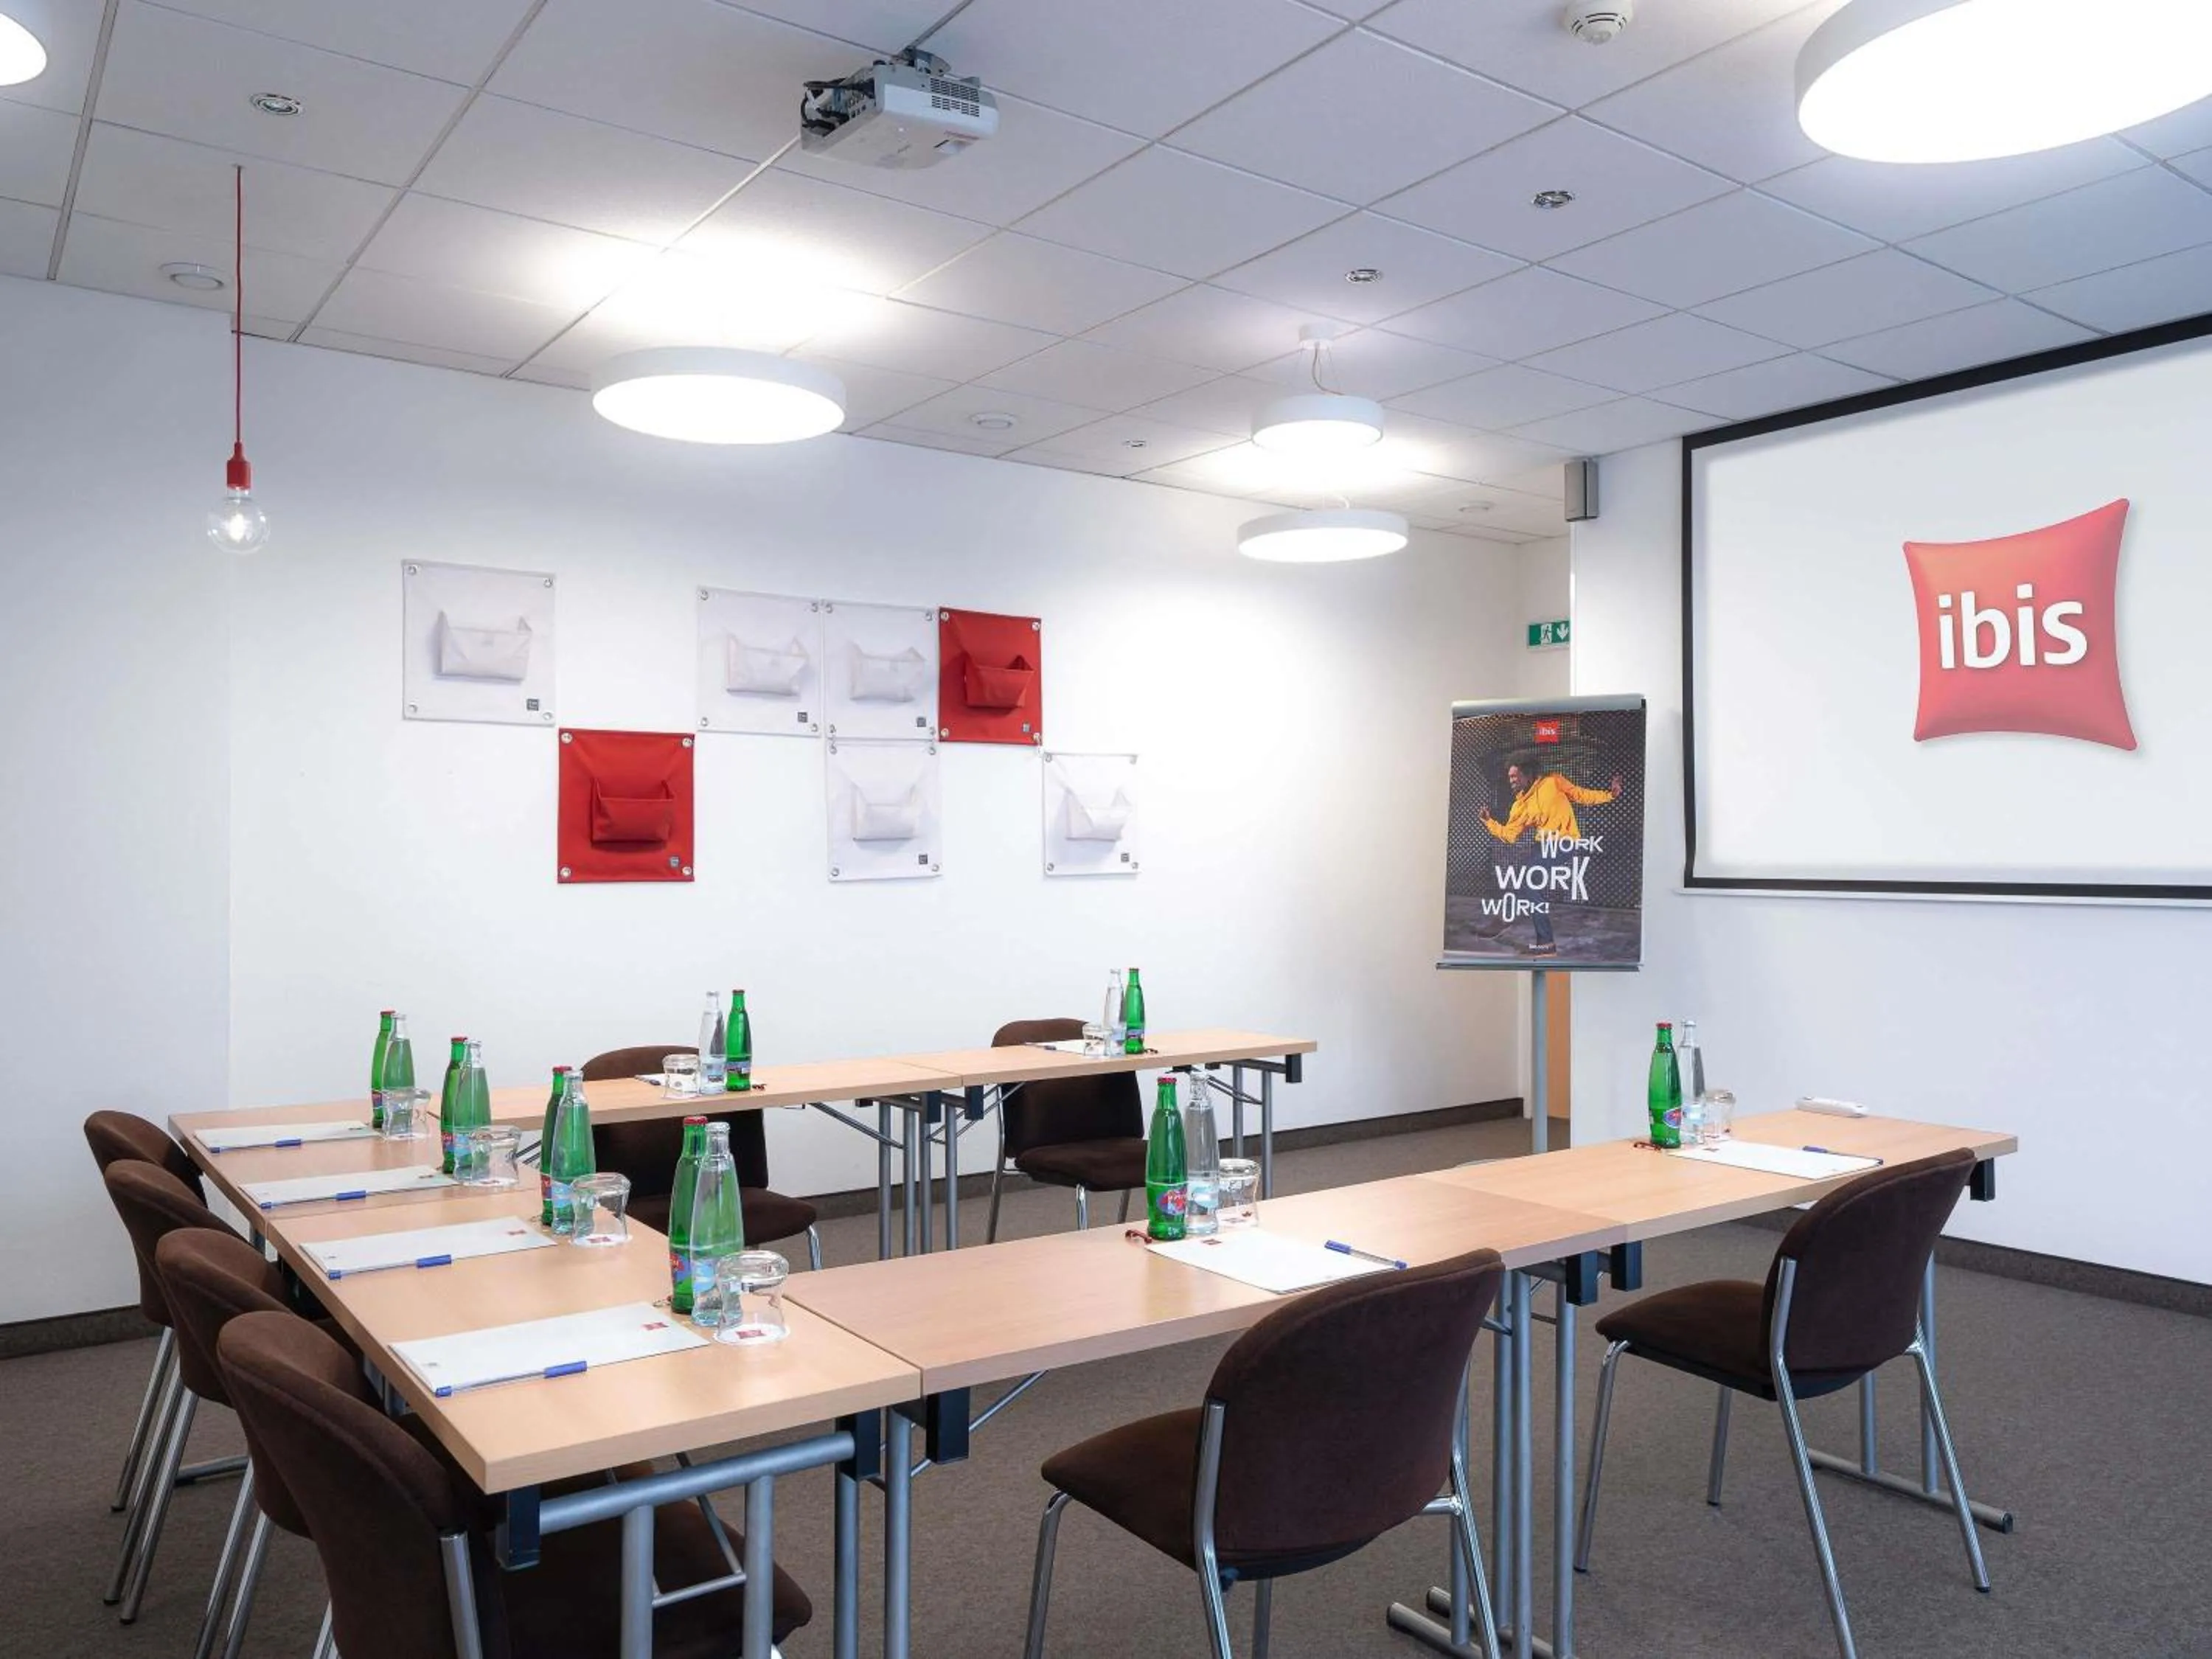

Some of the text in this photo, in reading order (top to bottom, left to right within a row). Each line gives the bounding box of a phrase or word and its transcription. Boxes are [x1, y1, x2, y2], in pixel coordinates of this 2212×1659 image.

[1938, 583, 2087, 669] ibis
[1541, 830, 1604, 859] WORK
[1495, 856, 1590, 901] WORK
[1481, 892, 1550, 922] WORK!
